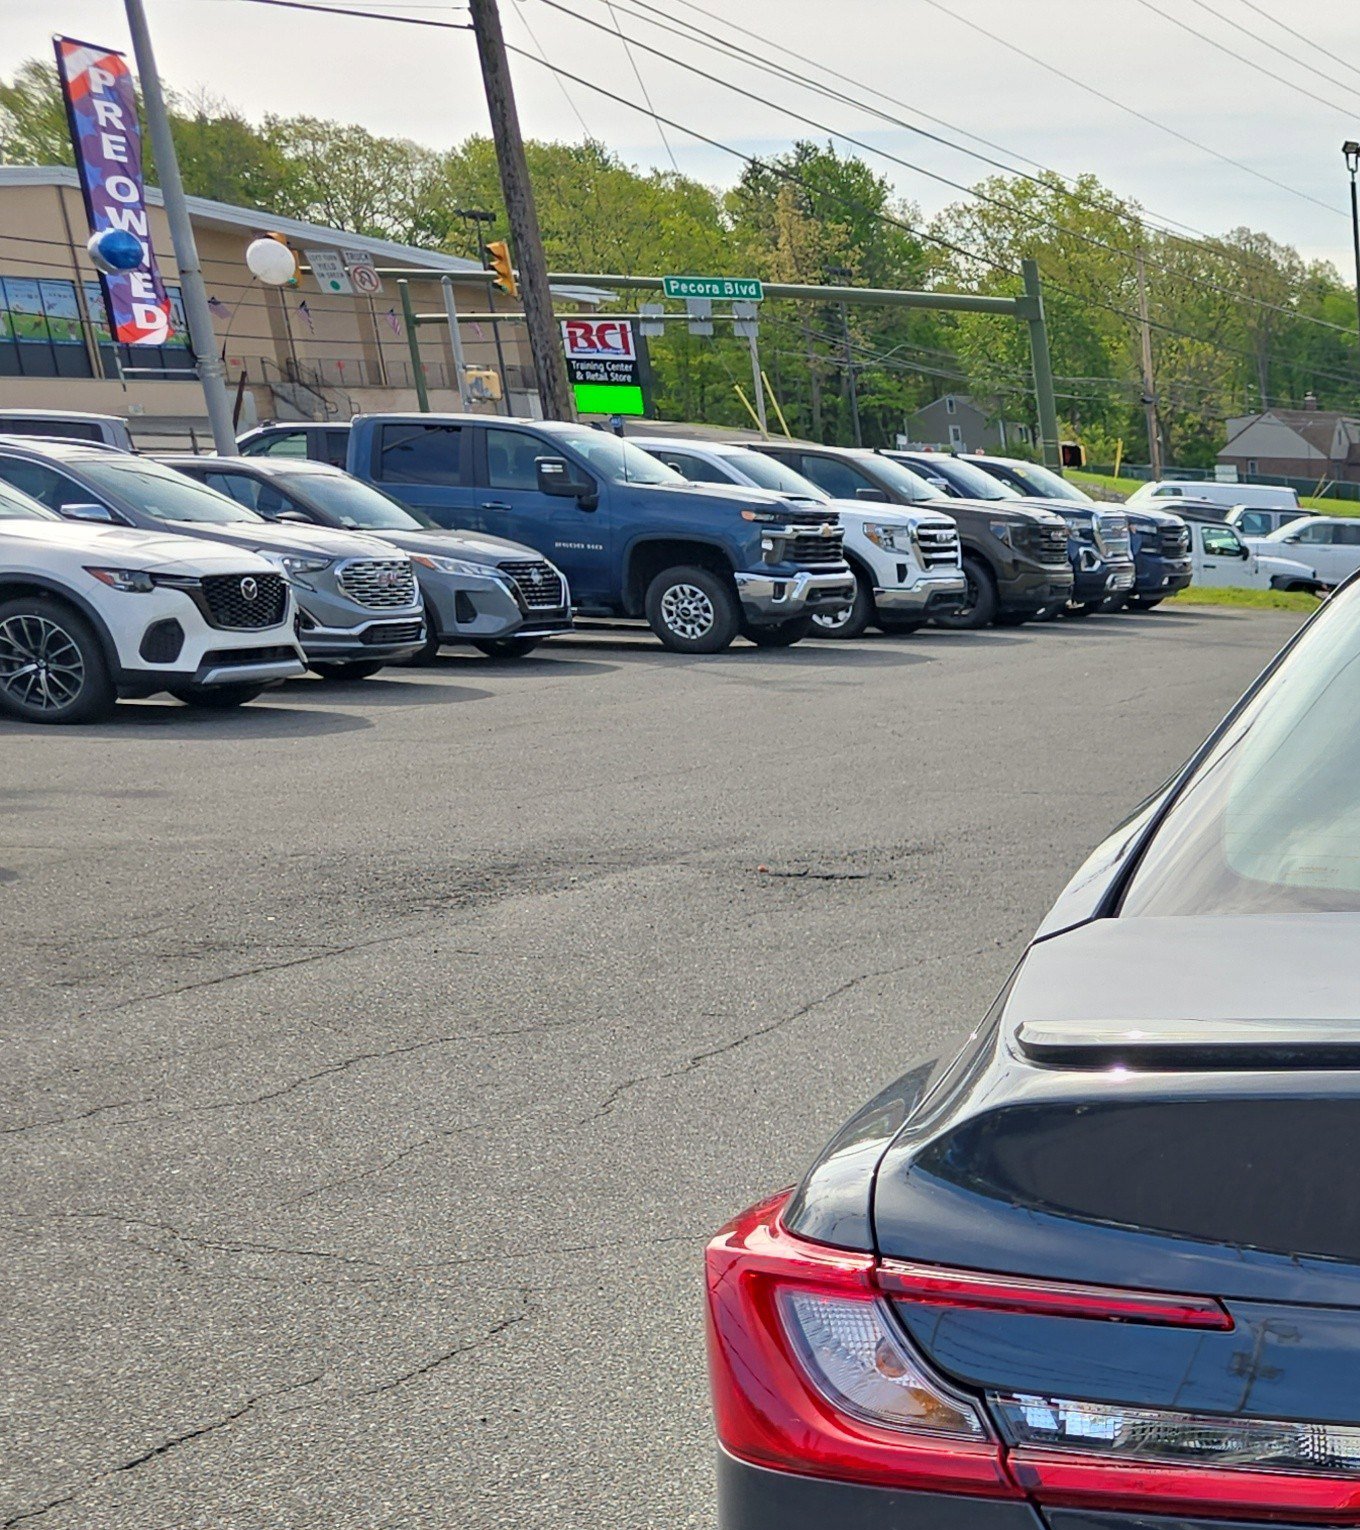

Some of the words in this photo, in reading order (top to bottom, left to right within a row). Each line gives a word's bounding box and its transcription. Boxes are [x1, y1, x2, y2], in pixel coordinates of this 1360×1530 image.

[88, 64, 128, 163] PRE
[669, 280, 720, 295] Pecora
[724, 281, 757, 296] Blvd
[565, 320, 632, 356] BCI
[571, 360, 606, 373] Training
[605, 361, 633, 372] Center
[575, 370, 584, 381] &
[585, 371, 609, 382] Retail
[609, 372, 632, 383] Store
